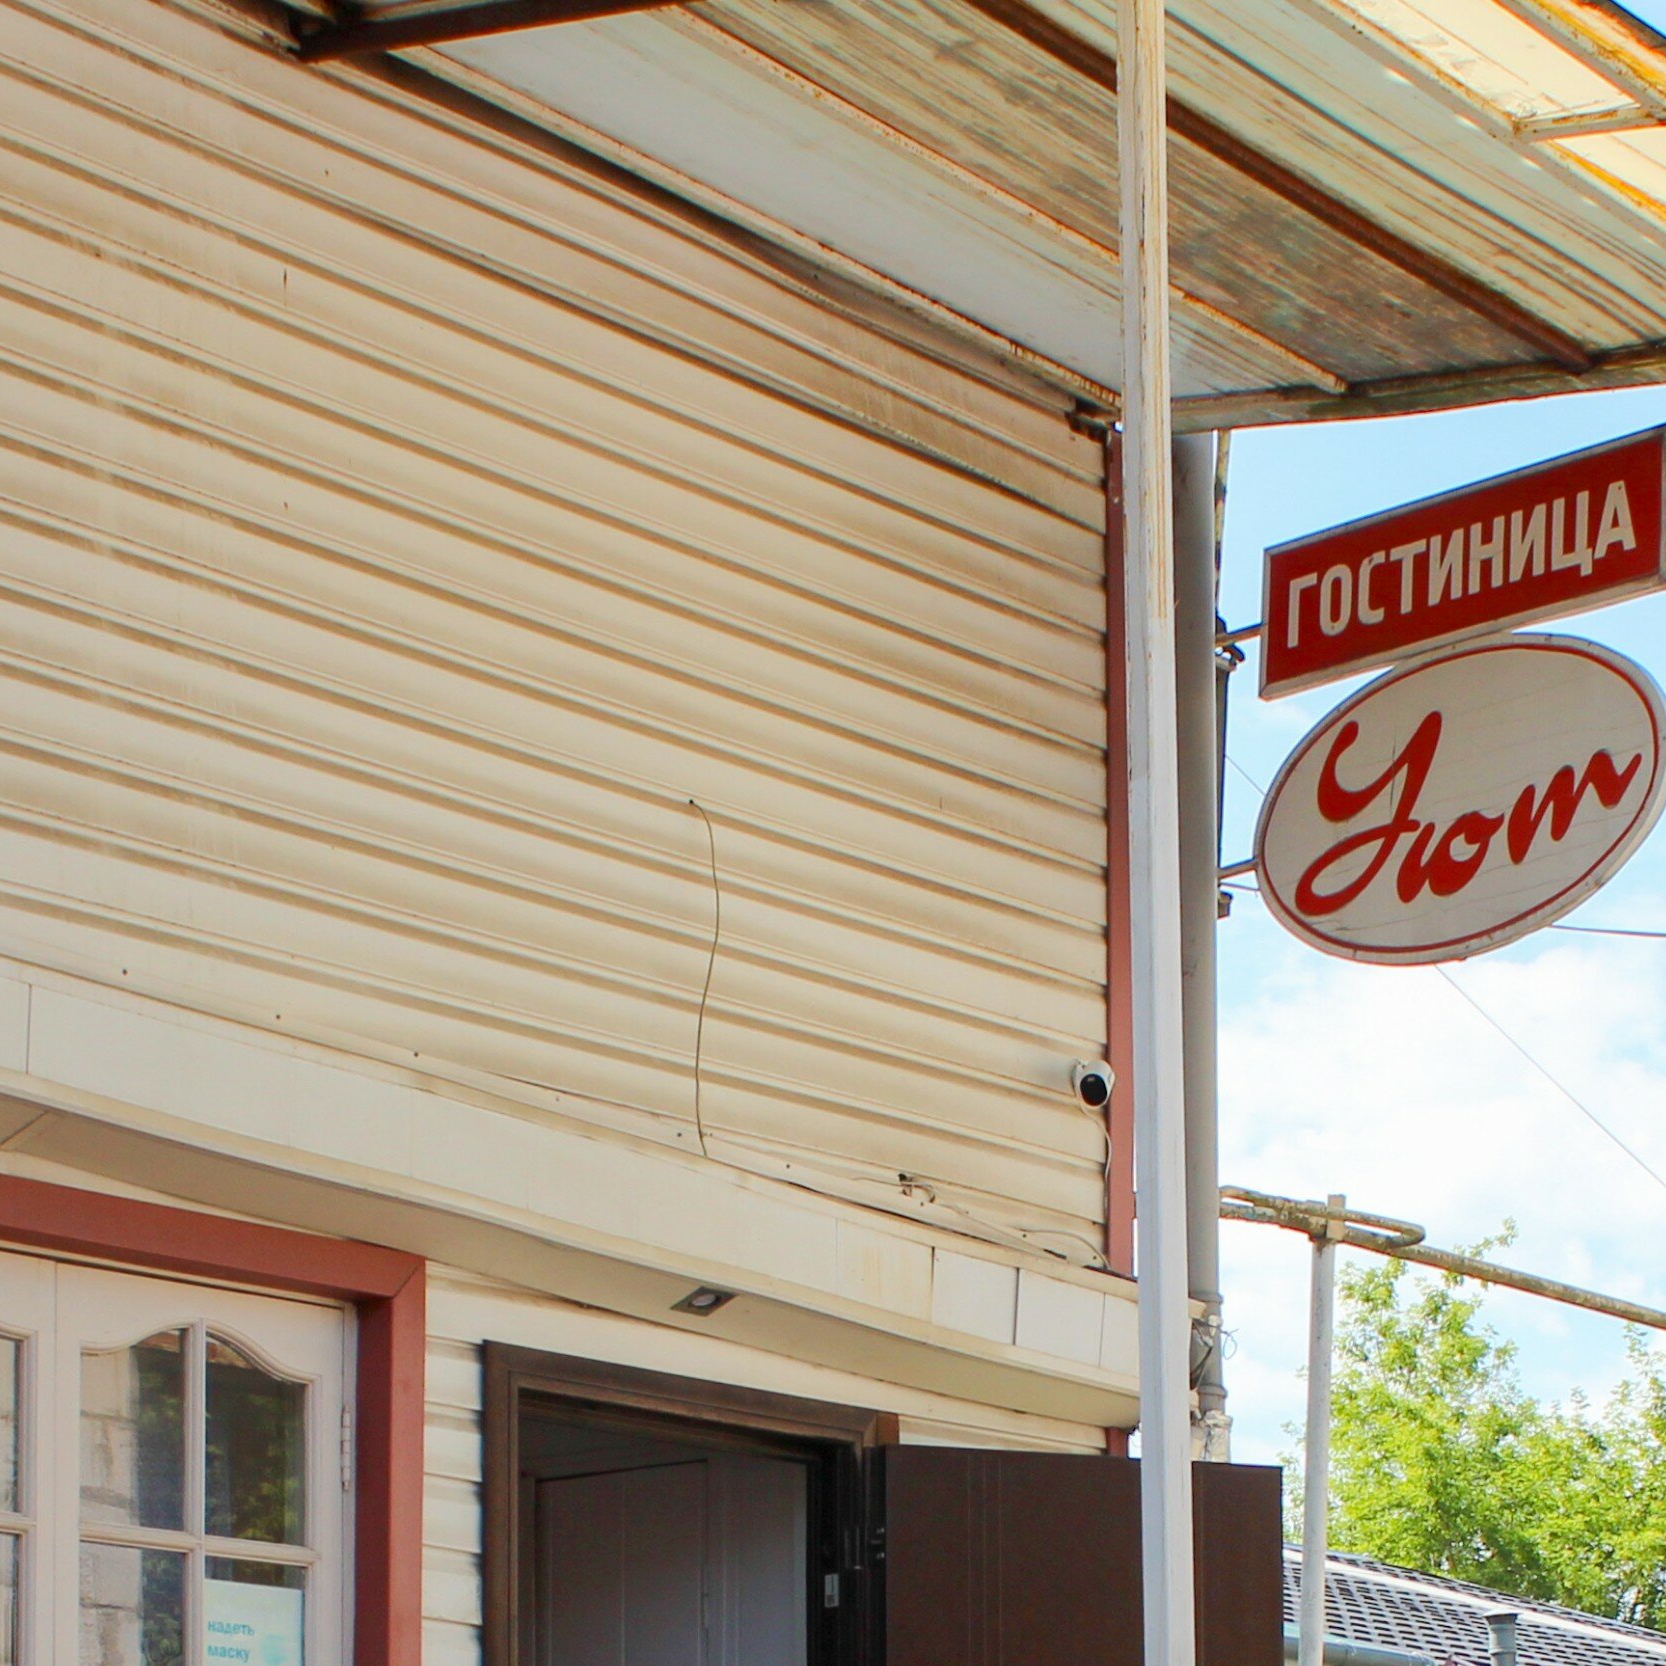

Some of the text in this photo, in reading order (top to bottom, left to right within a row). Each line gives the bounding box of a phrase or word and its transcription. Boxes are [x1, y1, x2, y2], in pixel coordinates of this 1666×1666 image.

[1286, 479, 1636, 648] ГОСТИНИЦА
[1294, 710, 1642, 917] Уют
[207, 1621, 255, 1636] надеть
[207, 1645, 251, 1663] маску
